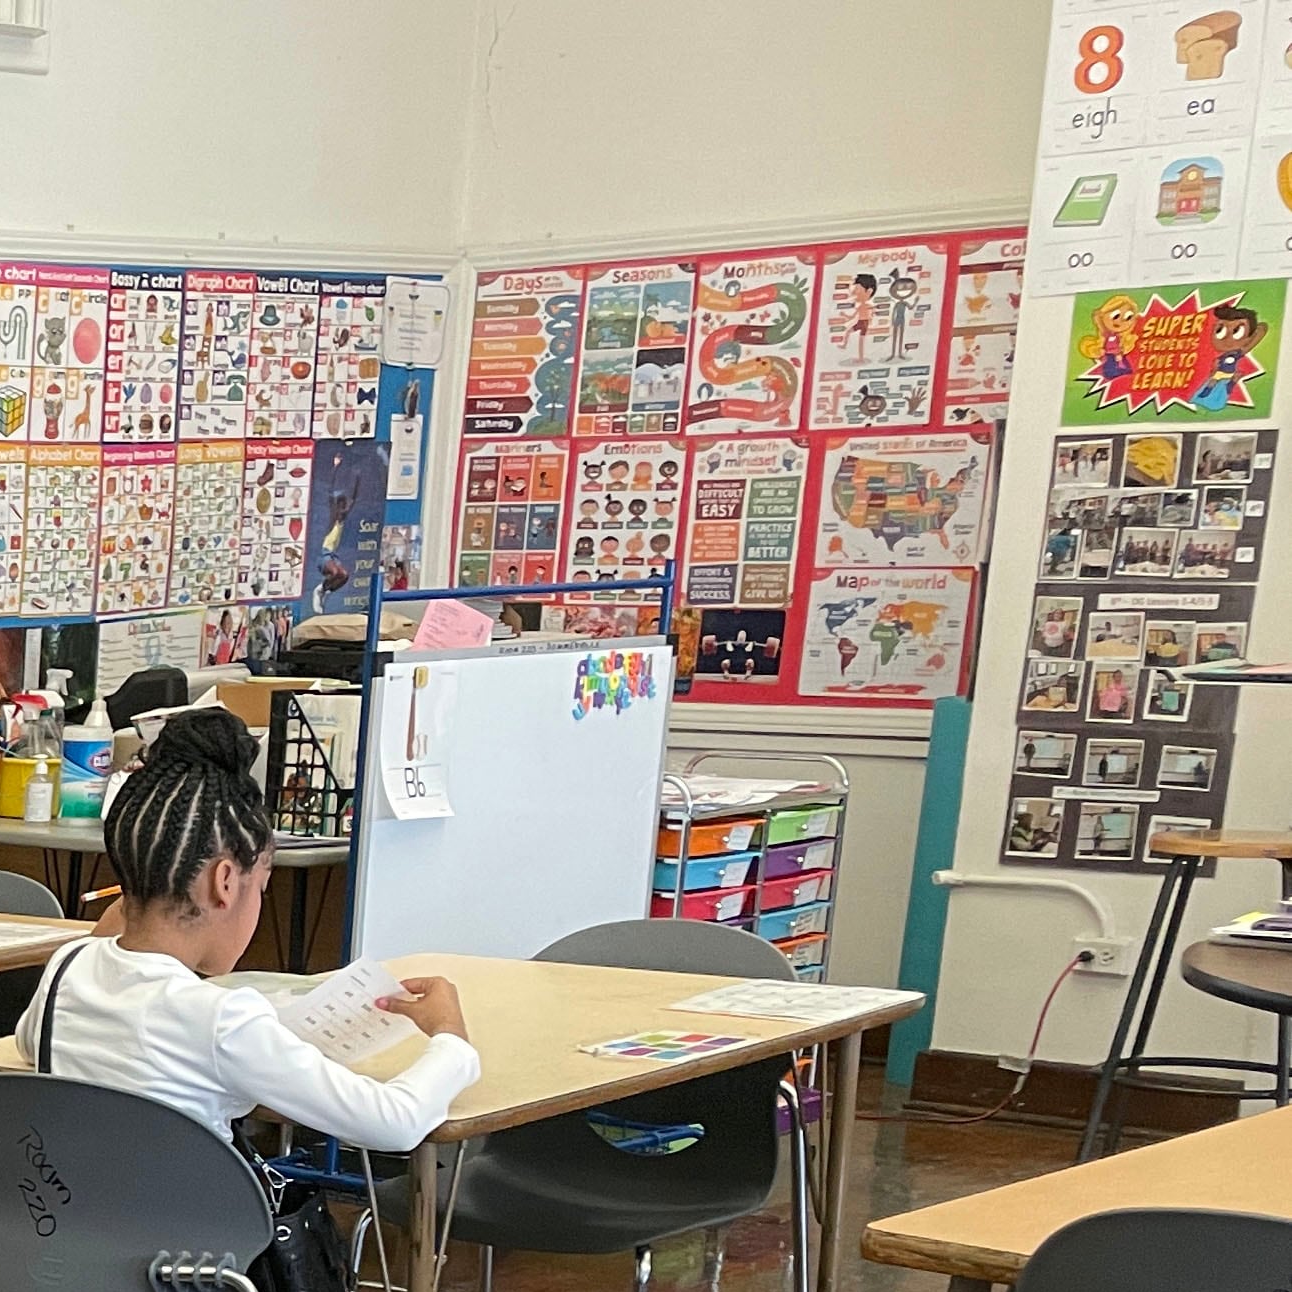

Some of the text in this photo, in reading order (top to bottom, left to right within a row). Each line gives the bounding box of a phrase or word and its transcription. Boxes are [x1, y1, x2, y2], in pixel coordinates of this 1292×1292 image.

[1074, 25, 1124, 94] 8
[1187, 98, 1215, 115] ea
[1072, 97, 1117, 139] eigh
[857, 248, 917, 267] My body
[1171, 243, 1197, 259] oo
[1068, 252, 1094, 268] oo
[4, 266, 37, 280] chart
[611, 266, 674, 284] Seasons
[722, 262, 781, 280] Months
[111, 271, 139, 288] Bossy
[151, 271, 182, 290] chart
[187, 273, 253, 292] Digraph Chart
[257, 275, 319, 294] Vowel Chart
[503, 275, 544, 295] Days
[1142, 312, 1208, 338] SUPER
[1138, 337, 1200, 353] STUDENTS
[1138, 352, 1198, 369] LOVE TO
[1132, 370, 1195, 390] LEARN!
[474, 418, 515, 430] Saturday
[30, 446, 73, 462] Alphabet
[494, 443, 543, 454] Manners
[603, 442, 664, 456] Emotions
[737, 441, 780, 456] growth
[723, 455, 778, 468] mindset
[698, 488, 745, 500] DIFFICULT
[701, 504, 737, 518] EASY
[835, 573, 948, 592] Map world
[689, 590, 732, 601] SUCCESS
[404, 766, 426, 798] Bb
[17, 1178, 57, 1237] 220
